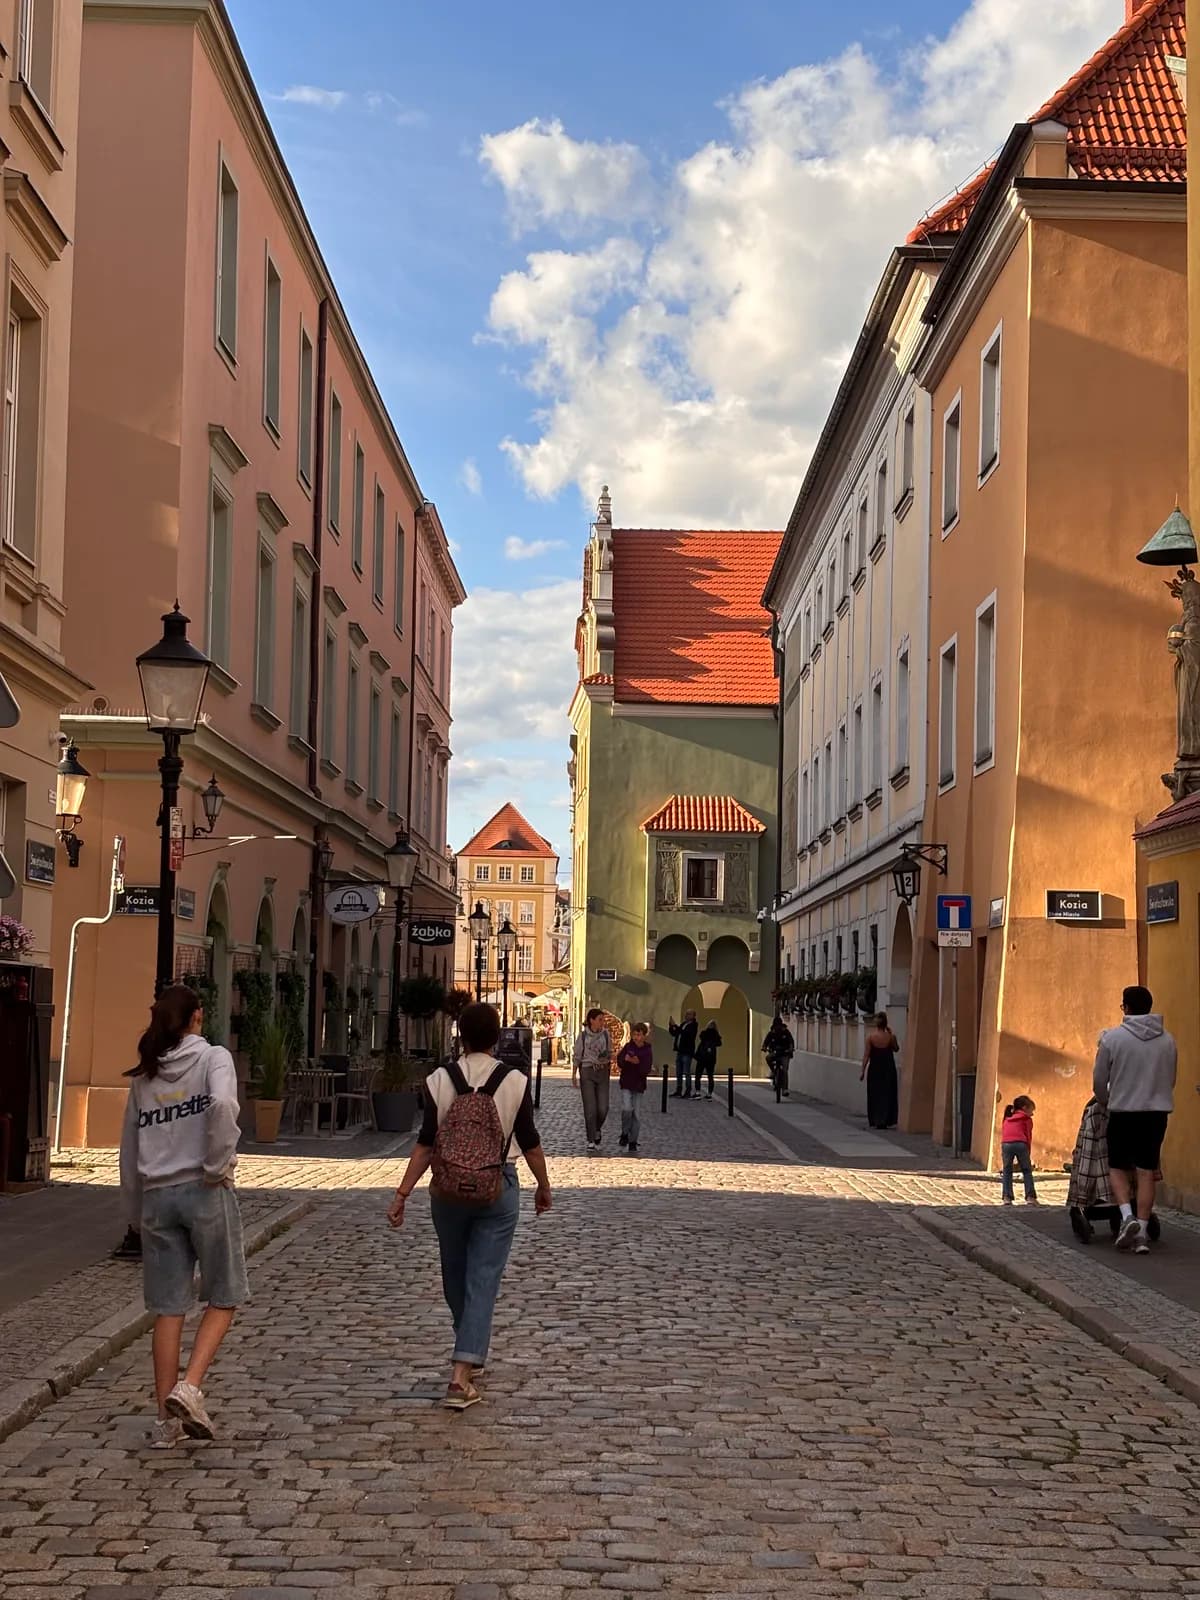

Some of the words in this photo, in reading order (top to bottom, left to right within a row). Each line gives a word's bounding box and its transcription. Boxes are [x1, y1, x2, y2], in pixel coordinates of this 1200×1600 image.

[905, 876, 912, 887] 2
[126, 896, 154, 905] Kozia
[1060, 900, 1088, 909] Kozia
[412, 925, 451, 937] żabka
[138, 1094, 212, 1128] brunette
